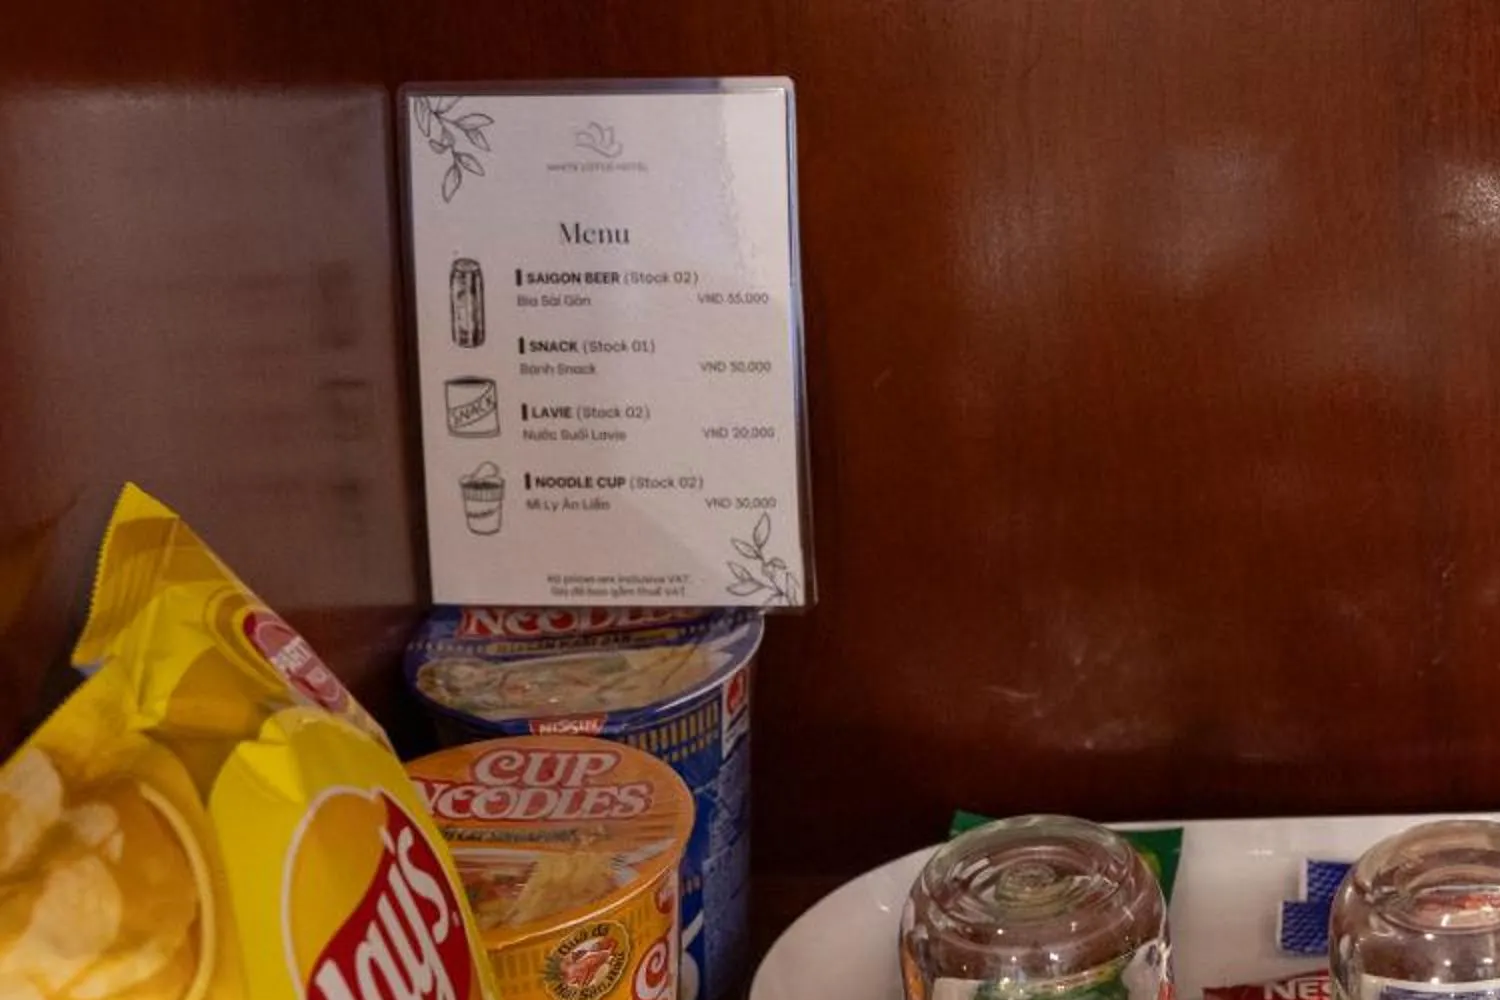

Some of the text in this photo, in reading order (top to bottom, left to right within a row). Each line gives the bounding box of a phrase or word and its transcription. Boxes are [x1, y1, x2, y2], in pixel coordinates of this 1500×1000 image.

[559, 222, 630, 245] Menu
[526, 271, 581, 285] SAIGON
[584, 271, 620, 284] BEER
[529, 340, 579, 353] SNACK
[531, 406, 573, 419] LAVIE
[535, 476, 593, 489] NOODLE
[596, 476, 626, 488] CUP
[472, 749, 620, 787] CUP
[414, 780, 651, 820] NOODLES
